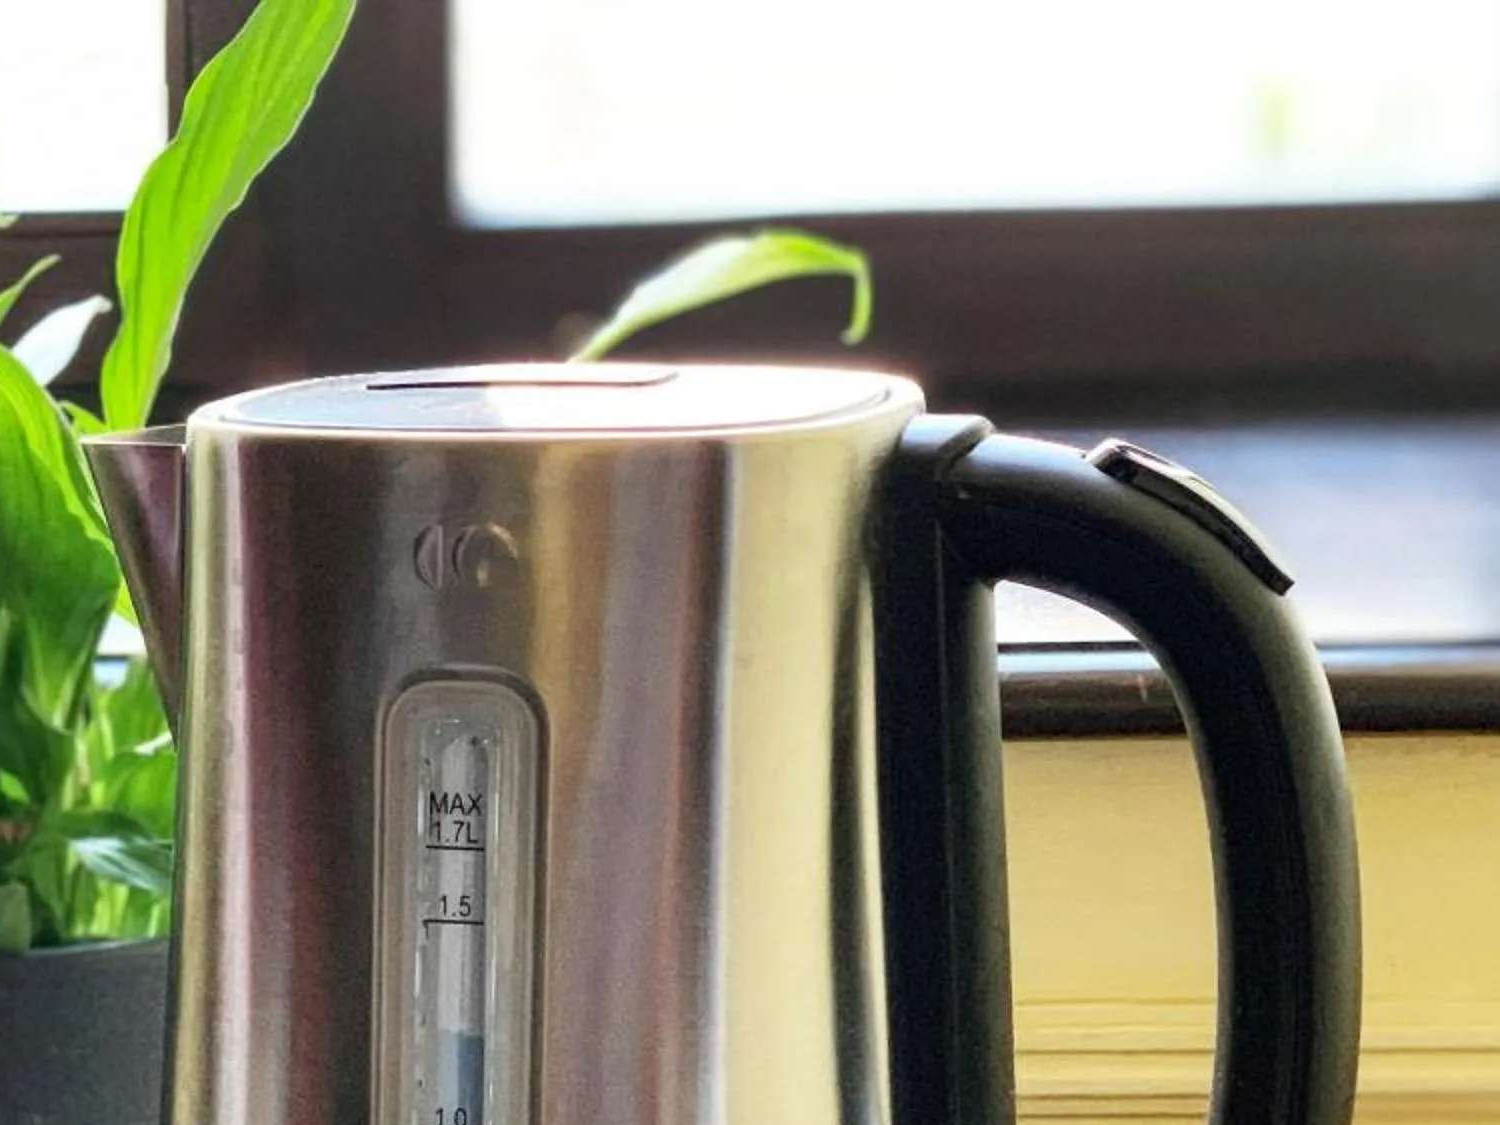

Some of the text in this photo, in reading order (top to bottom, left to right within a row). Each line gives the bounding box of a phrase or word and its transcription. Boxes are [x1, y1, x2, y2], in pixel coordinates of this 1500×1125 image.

[430, 792, 483, 816] MAX
[431, 820, 479, 845] 1.7L
[439, 895, 472, 918] 1.5
